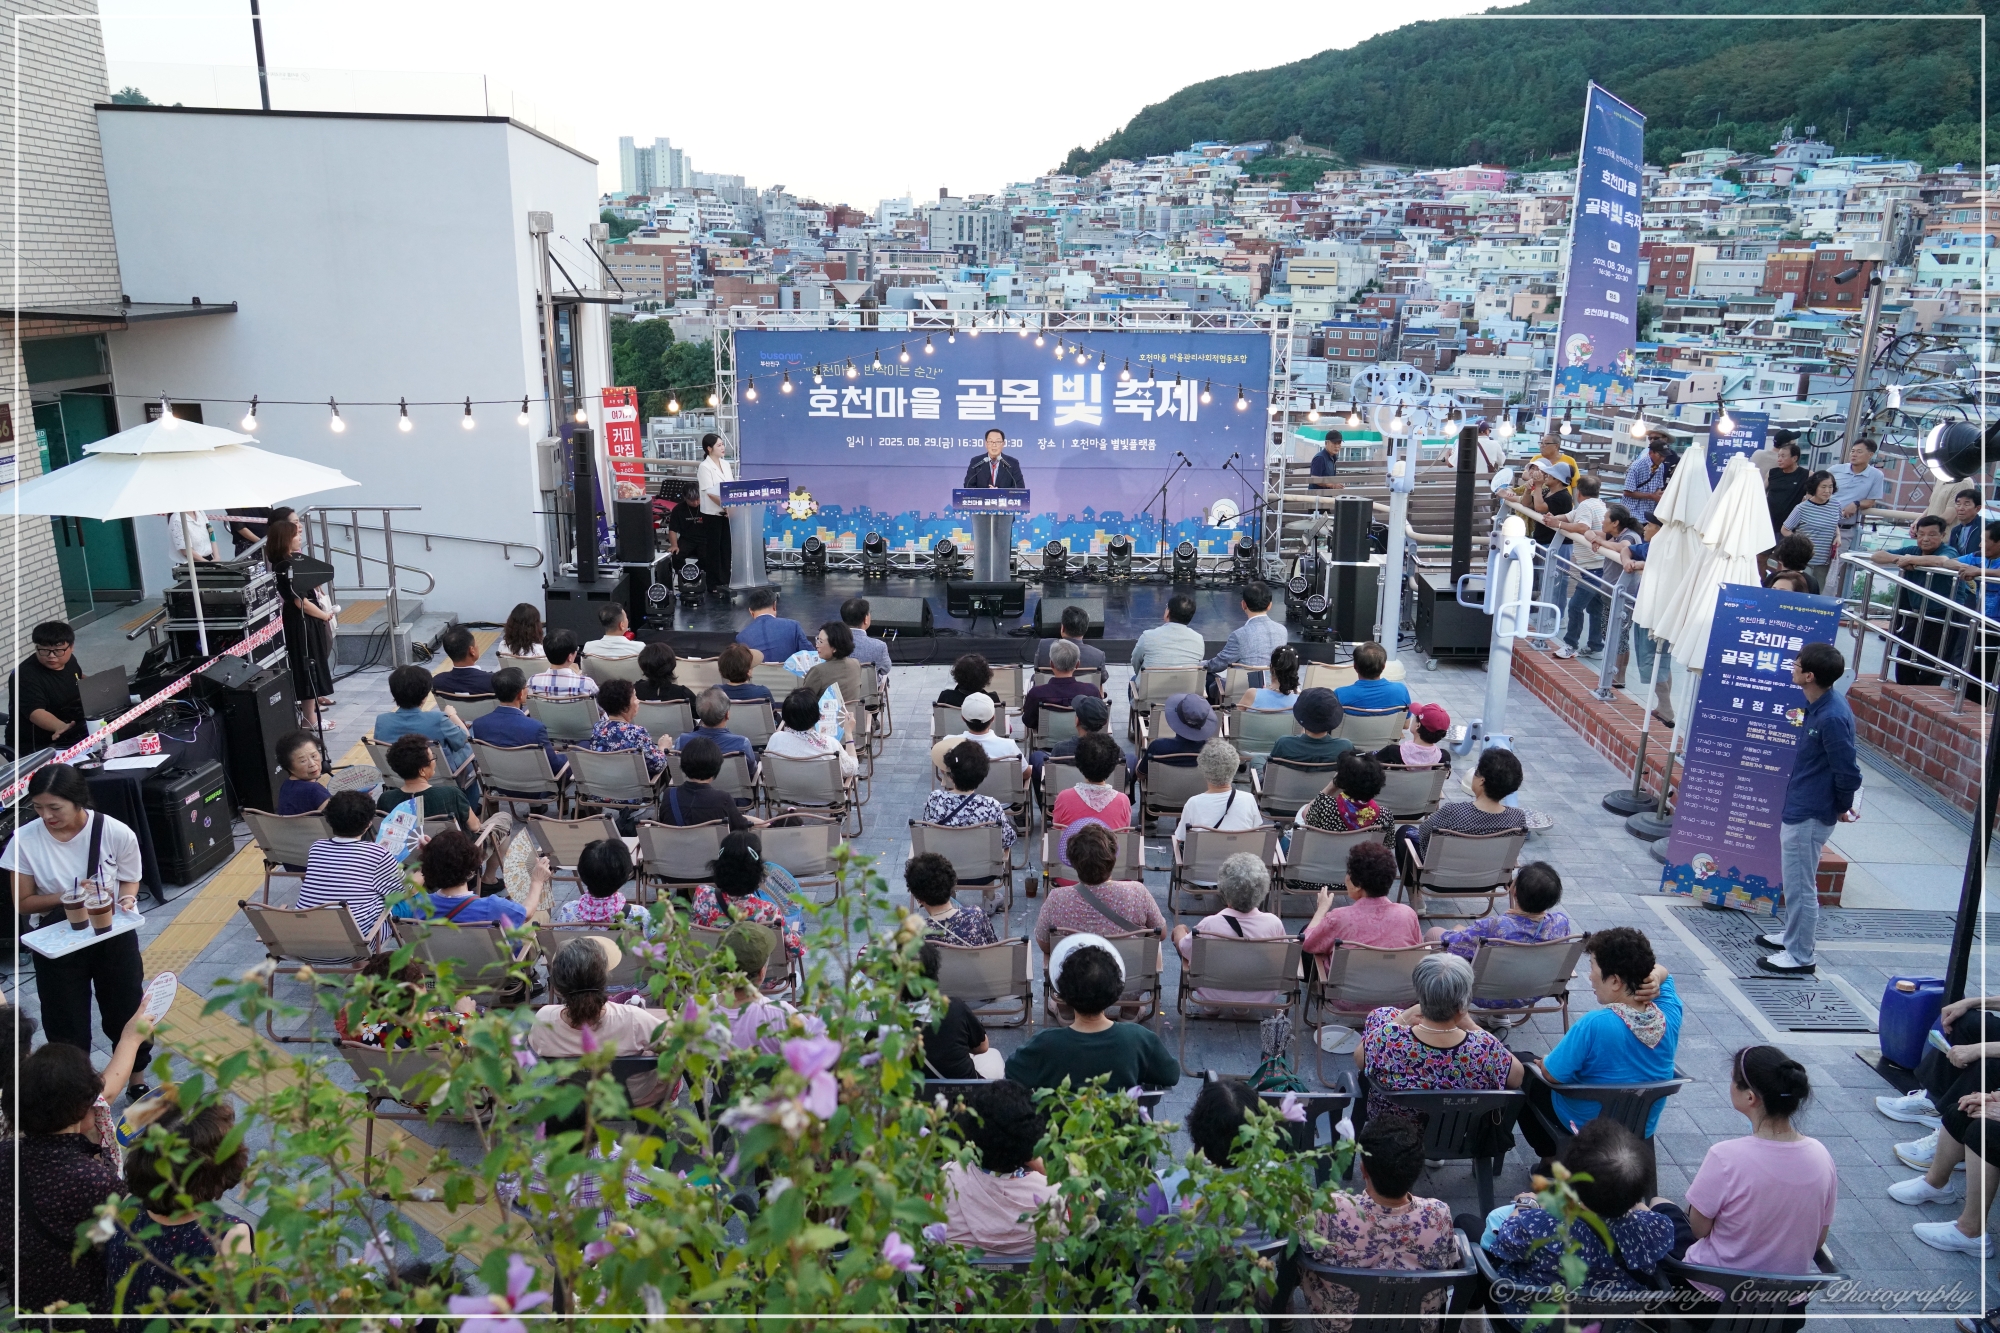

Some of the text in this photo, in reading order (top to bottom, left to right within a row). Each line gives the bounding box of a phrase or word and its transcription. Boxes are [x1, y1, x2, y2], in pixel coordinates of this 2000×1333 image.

[1601, 169, 1637, 197] 호천마을
[1585, 197, 1610, 218] 골목
[1610, 201, 1623, 225] 빛
[1599, 268, 1611, 277] 16:30
[1583, 307, 1609, 318] 호천마을
[759, 350, 803, 362] busanjin
[1138, 352, 1247, 364] 호천마을 마을관리사회적협동조합
[760, 360, 780, 368] 부산진구
[808, 373, 1199, 426] 호천마을 골목 빛 축제
[612, 427, 634, 443] 커피
[846, 436, 864, 448] 일시
[878, 437, 905, 447] 2025.
[907, 437, 922, 447] 08.
[957, 438, 984, 448] 16:30
[1037, 438, 1057, 450] 장소
[1070, 438, 1108, 451] 호천마을
[1110, 438, 1157, 451] 별빛플랫폼
[614, 444, 635, 458] 맛집
[1726, 596, 1757, 606] busanjin
[1739, 629, 1804, 651] 호천마을
[1721, 649, 1755, 667] 골목
[1756, 650, 1780, 672] 빛
